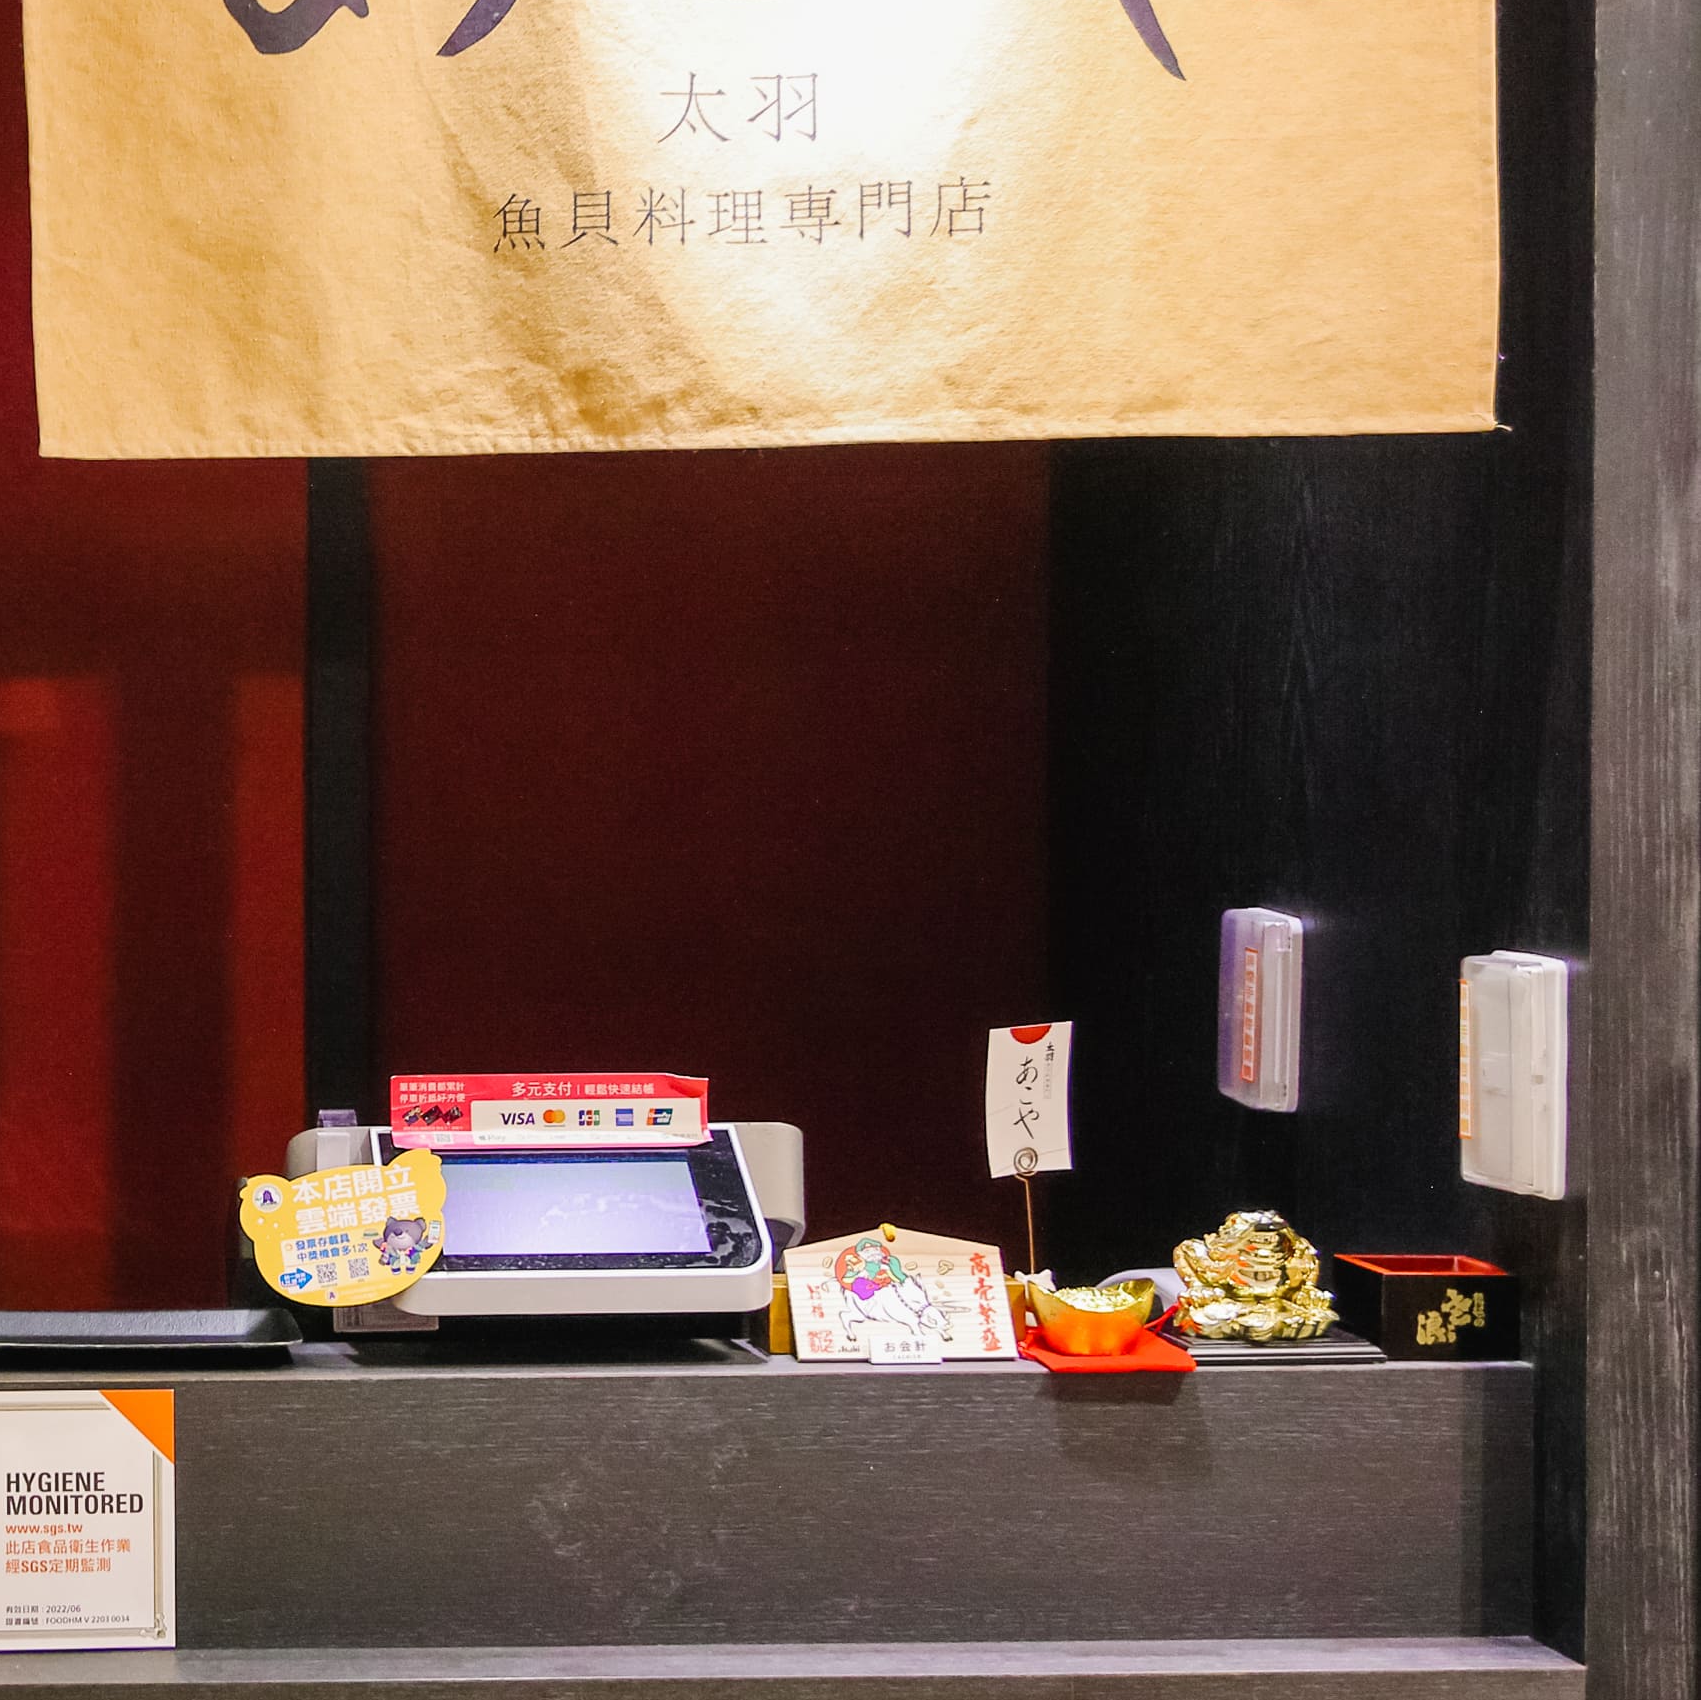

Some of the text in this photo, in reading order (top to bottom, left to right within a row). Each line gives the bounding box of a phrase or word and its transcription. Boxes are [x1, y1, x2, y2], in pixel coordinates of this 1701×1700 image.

[659, 72, 819, 143] 太羽
[492, 174, 992, 254] 魚貝料理専門店
[512, 1081, 572, 1097] 多元支付
[1013, 1056, 1040, 1140] あこや
[500, 1112, 535, 1125] VISA
[291, 1165, 416, 1206] 本店開立
[295, 1190, 421, 1234] 雲端發票
[6, 1471, 106, 1493] HYGIENE
[6, 1493, 145, 1516] MONITORED
[5, 1522, 83, 1537] www.sgs.tw
[5, 1538, 131, 1556] 此店食品衛生作業
[5, 1557, 112, 1574] 經SGS定期監測
